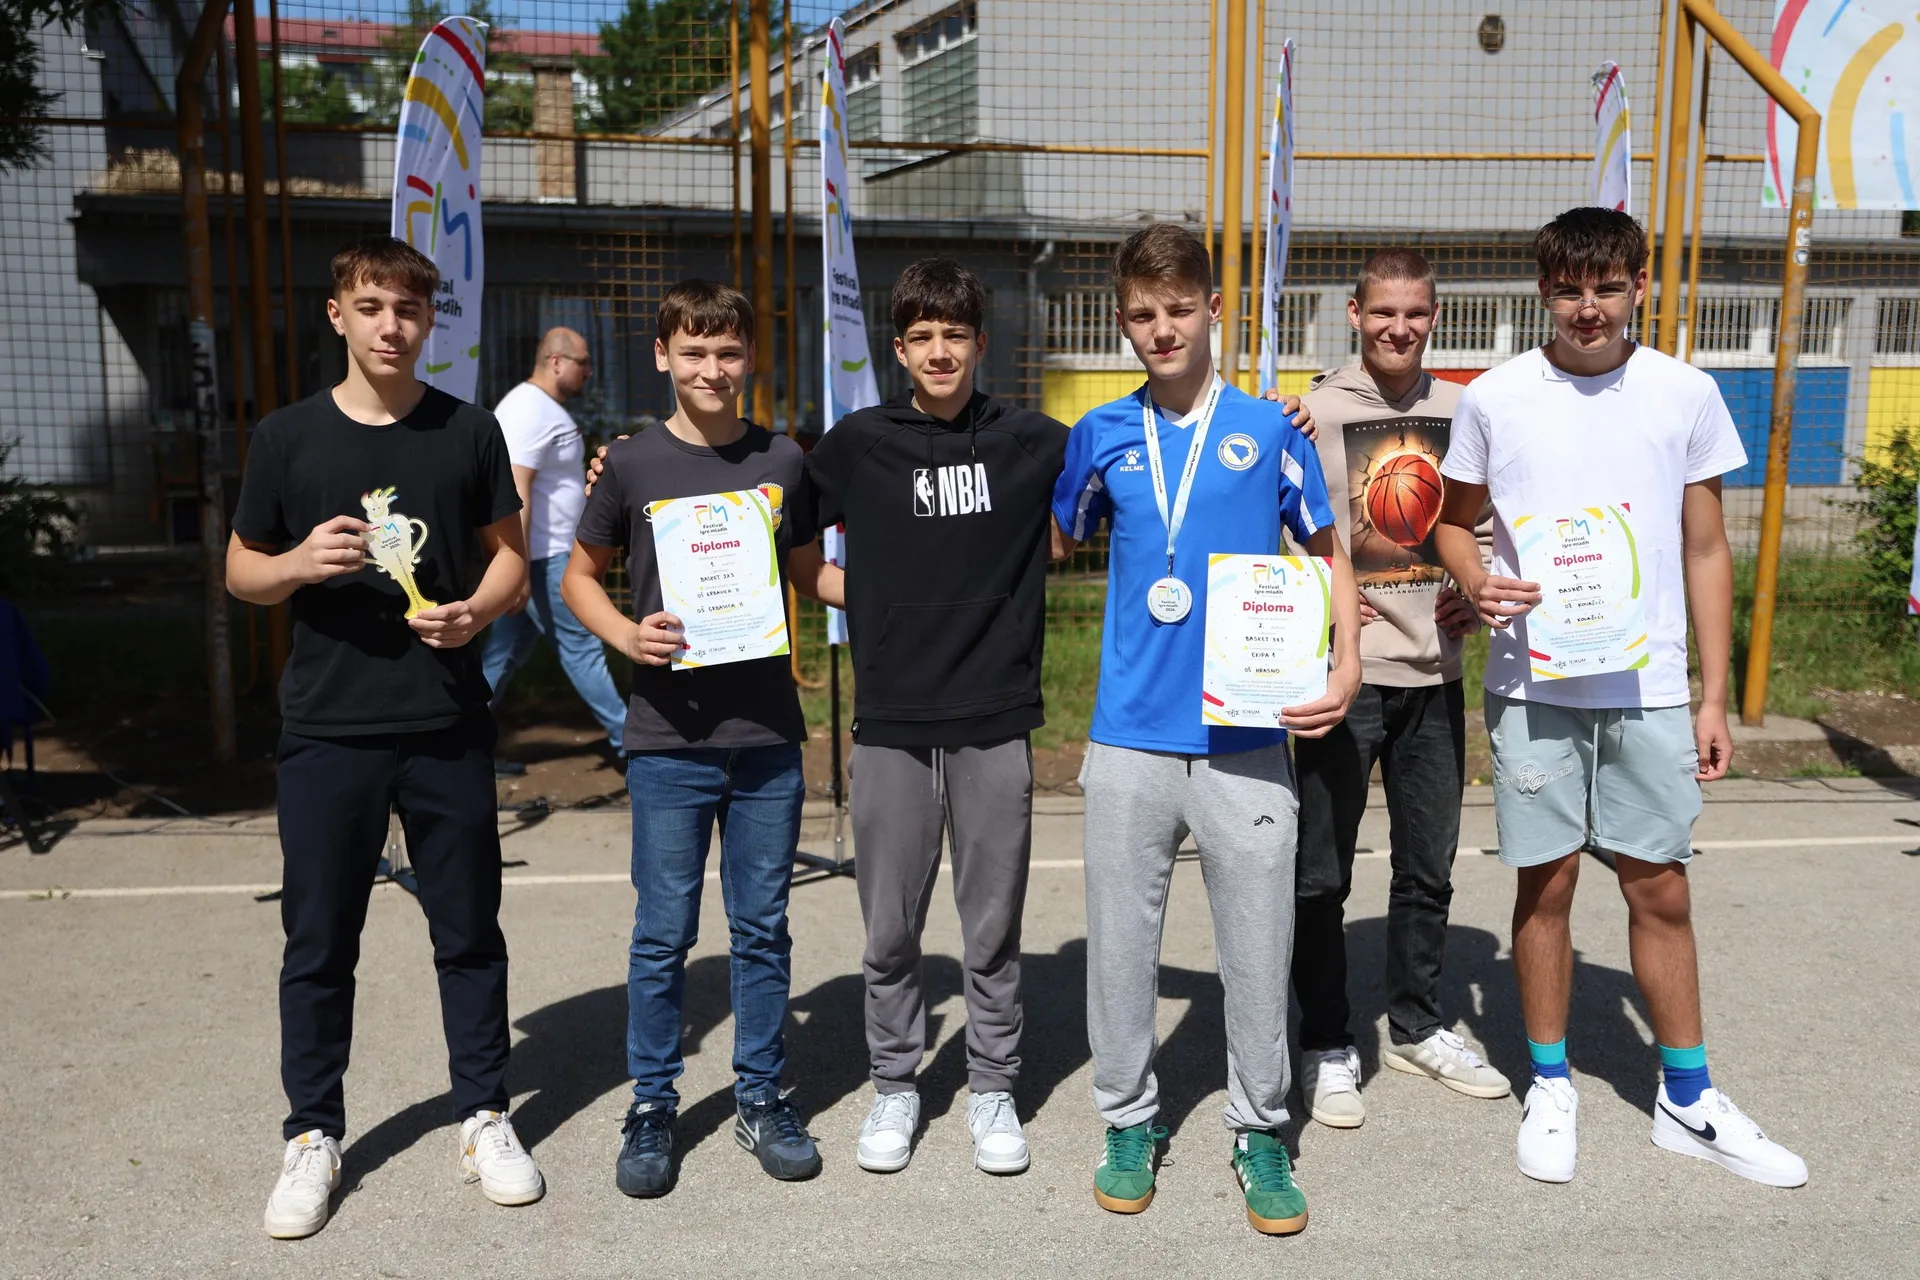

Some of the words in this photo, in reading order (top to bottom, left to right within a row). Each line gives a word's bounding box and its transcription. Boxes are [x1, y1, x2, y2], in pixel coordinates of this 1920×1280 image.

[938, 463, 992, 517] NBA
[691, 540, 741, 554] Diploma
[1553, 553, 1603, 567] Diploma
[700, 574, 720, 582] BASKET
[1363, 580, 1401, 591] PLAY
[1558, 585, 1583, 594] BASKET
[708, 603, 736, 612] GRBAVICA
[1243, 601, 1294, 614] Diploma
